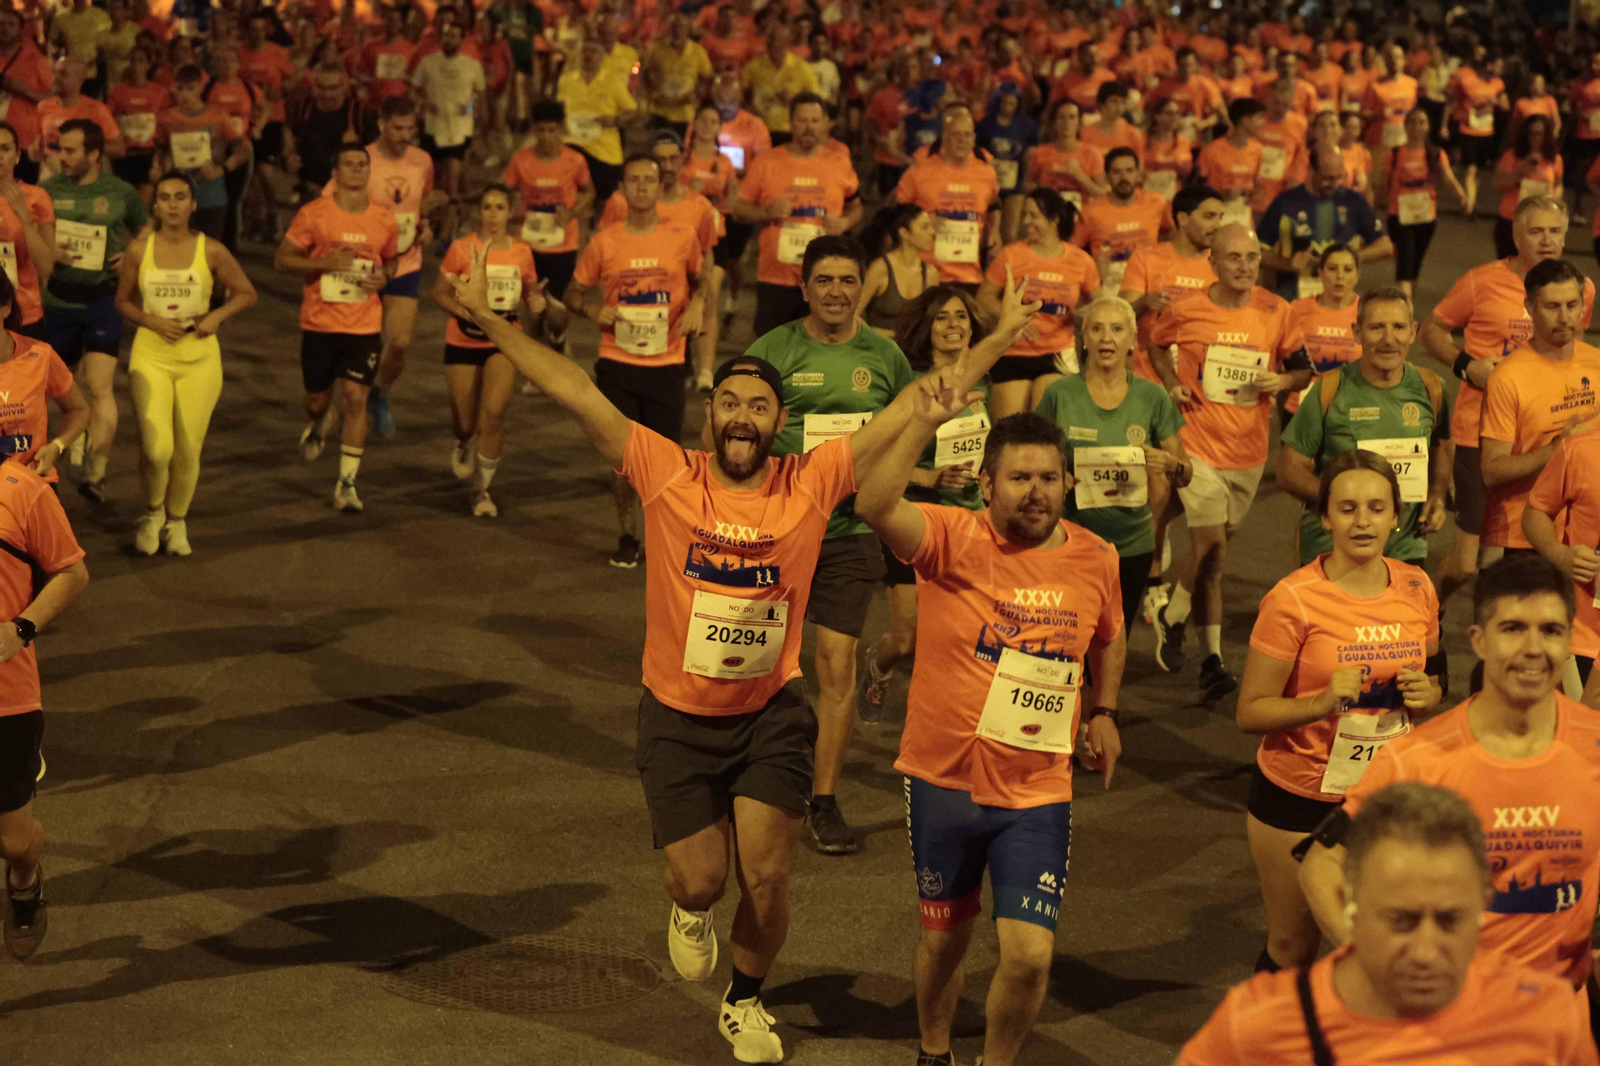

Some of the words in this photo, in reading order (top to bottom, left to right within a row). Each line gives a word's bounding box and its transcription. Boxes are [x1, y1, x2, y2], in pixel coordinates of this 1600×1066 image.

[155, 286, 191, 298] 22339
[630, 324, 657, 335] 7796
[1217, 332, 1249, 343] XXXV
[1216, 367, 1254, 383] 13881
[1564, 390, 1594, 402] NOCTURNA
[0, 402, 24, 411] TURNA
[1550, 401, 1579, 413] SEVILLA
[952, 438, 982, 454] 5425
[1393, 462, 1411, 475] 97
[1094, 470, 1129, 482] 5430
[714, 520, 758, 540] XXXV
[696, 528, 774, 548] GUADALQUIVIR
[694, 542, 715, 553] KH7
[686, 570, 700, 578] 2025
[1014, 588, 1063, 607] XXXV
[999, 610, 1078, 628] GUADALQUIVIR
[1035, 608, 1078, 618] NOCTURNA
[706, 624, 767, 646] 20294
[994, 622, 1014, 636] KH7
[1354, 623, 1400, 642] XXXV
[1337, 644, 1376, 652] CARRERA
[1378, 641, 1420, 650] NOCTURNA
[1344, 648, 1422, 662] GUADALQUIVIR
[1011, 688, 1064, 714] 19665
[1349, 744, 1383, 761] 21
[1493, 805, 1561, 829] XXXV
[1523, 830, 1582, 838] NOCTURNA
[1486, 840, 1582, 851] ADALQUIVIR
[1021, 896, 1029, 909] X
